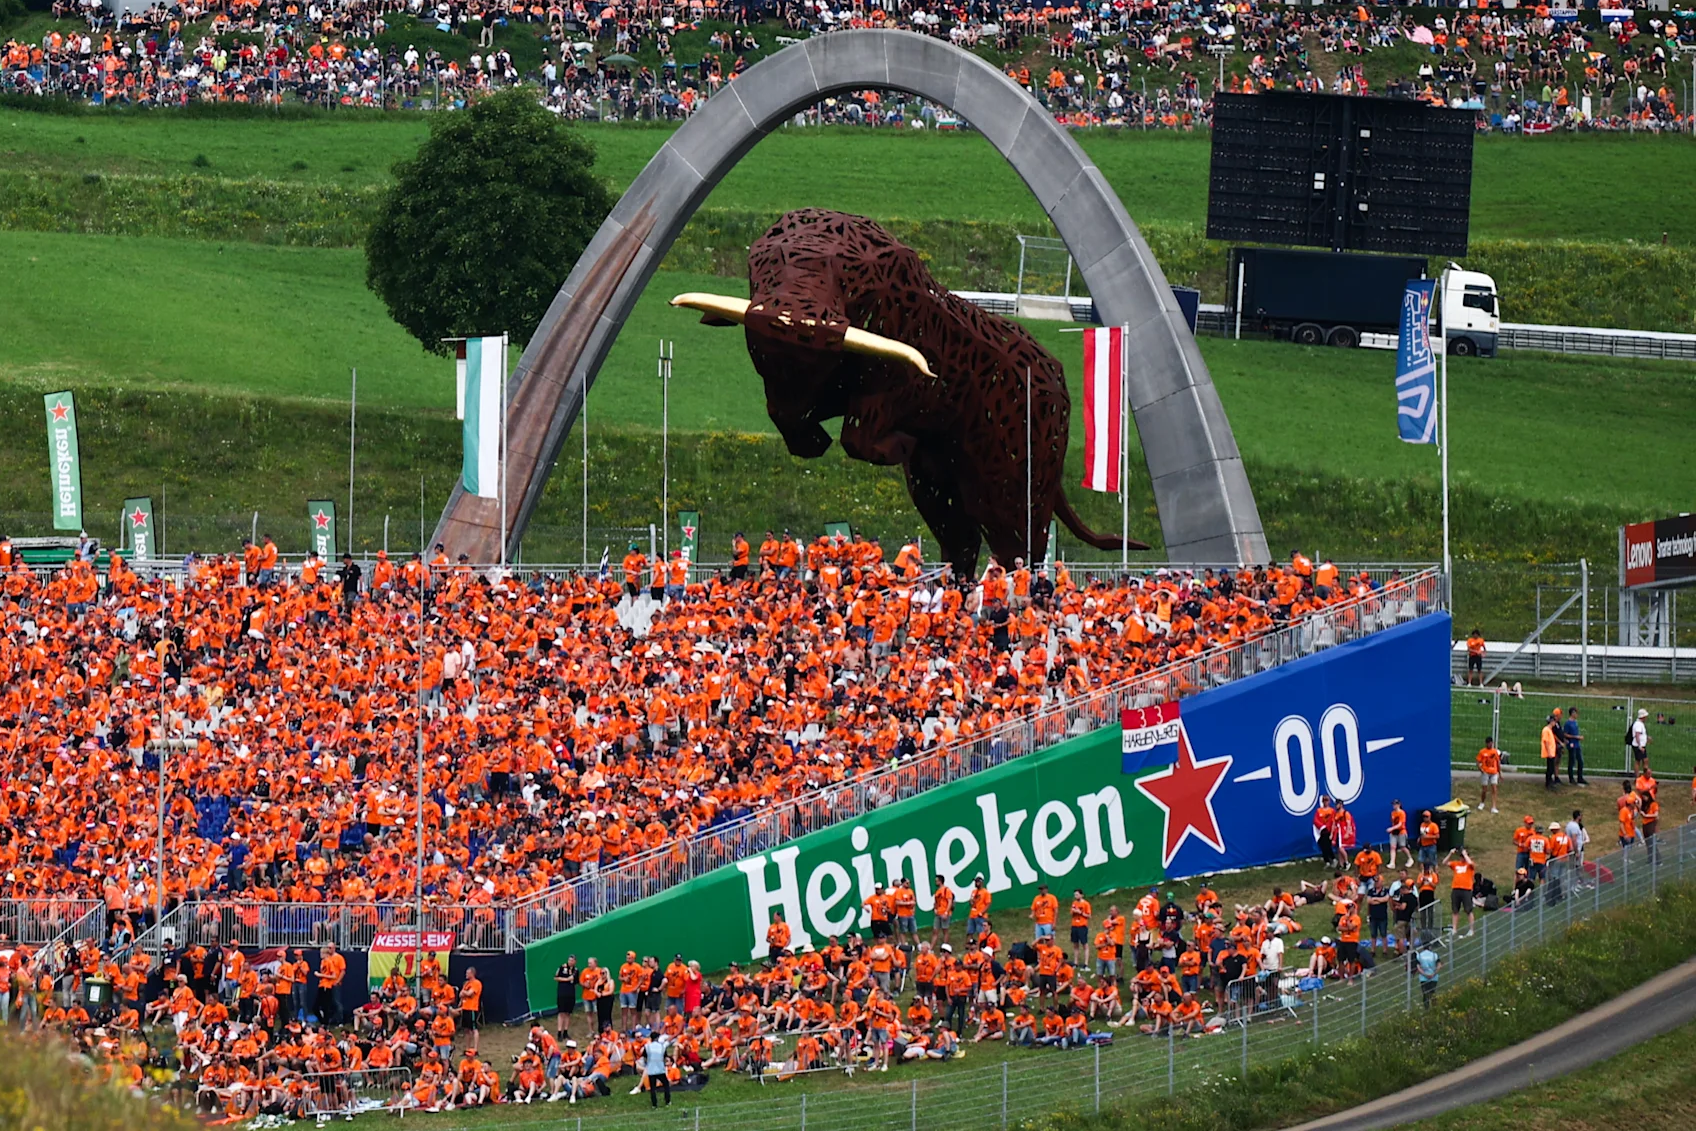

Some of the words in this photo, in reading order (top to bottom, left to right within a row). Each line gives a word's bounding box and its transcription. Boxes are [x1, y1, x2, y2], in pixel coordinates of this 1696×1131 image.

[1626, 538, 1653, 569] Lenovo
[736, 785, 1134, 960] Heineken
[375, 934, 452, 948] KESSE-EIK
[404, 953, 415, 976] 1
